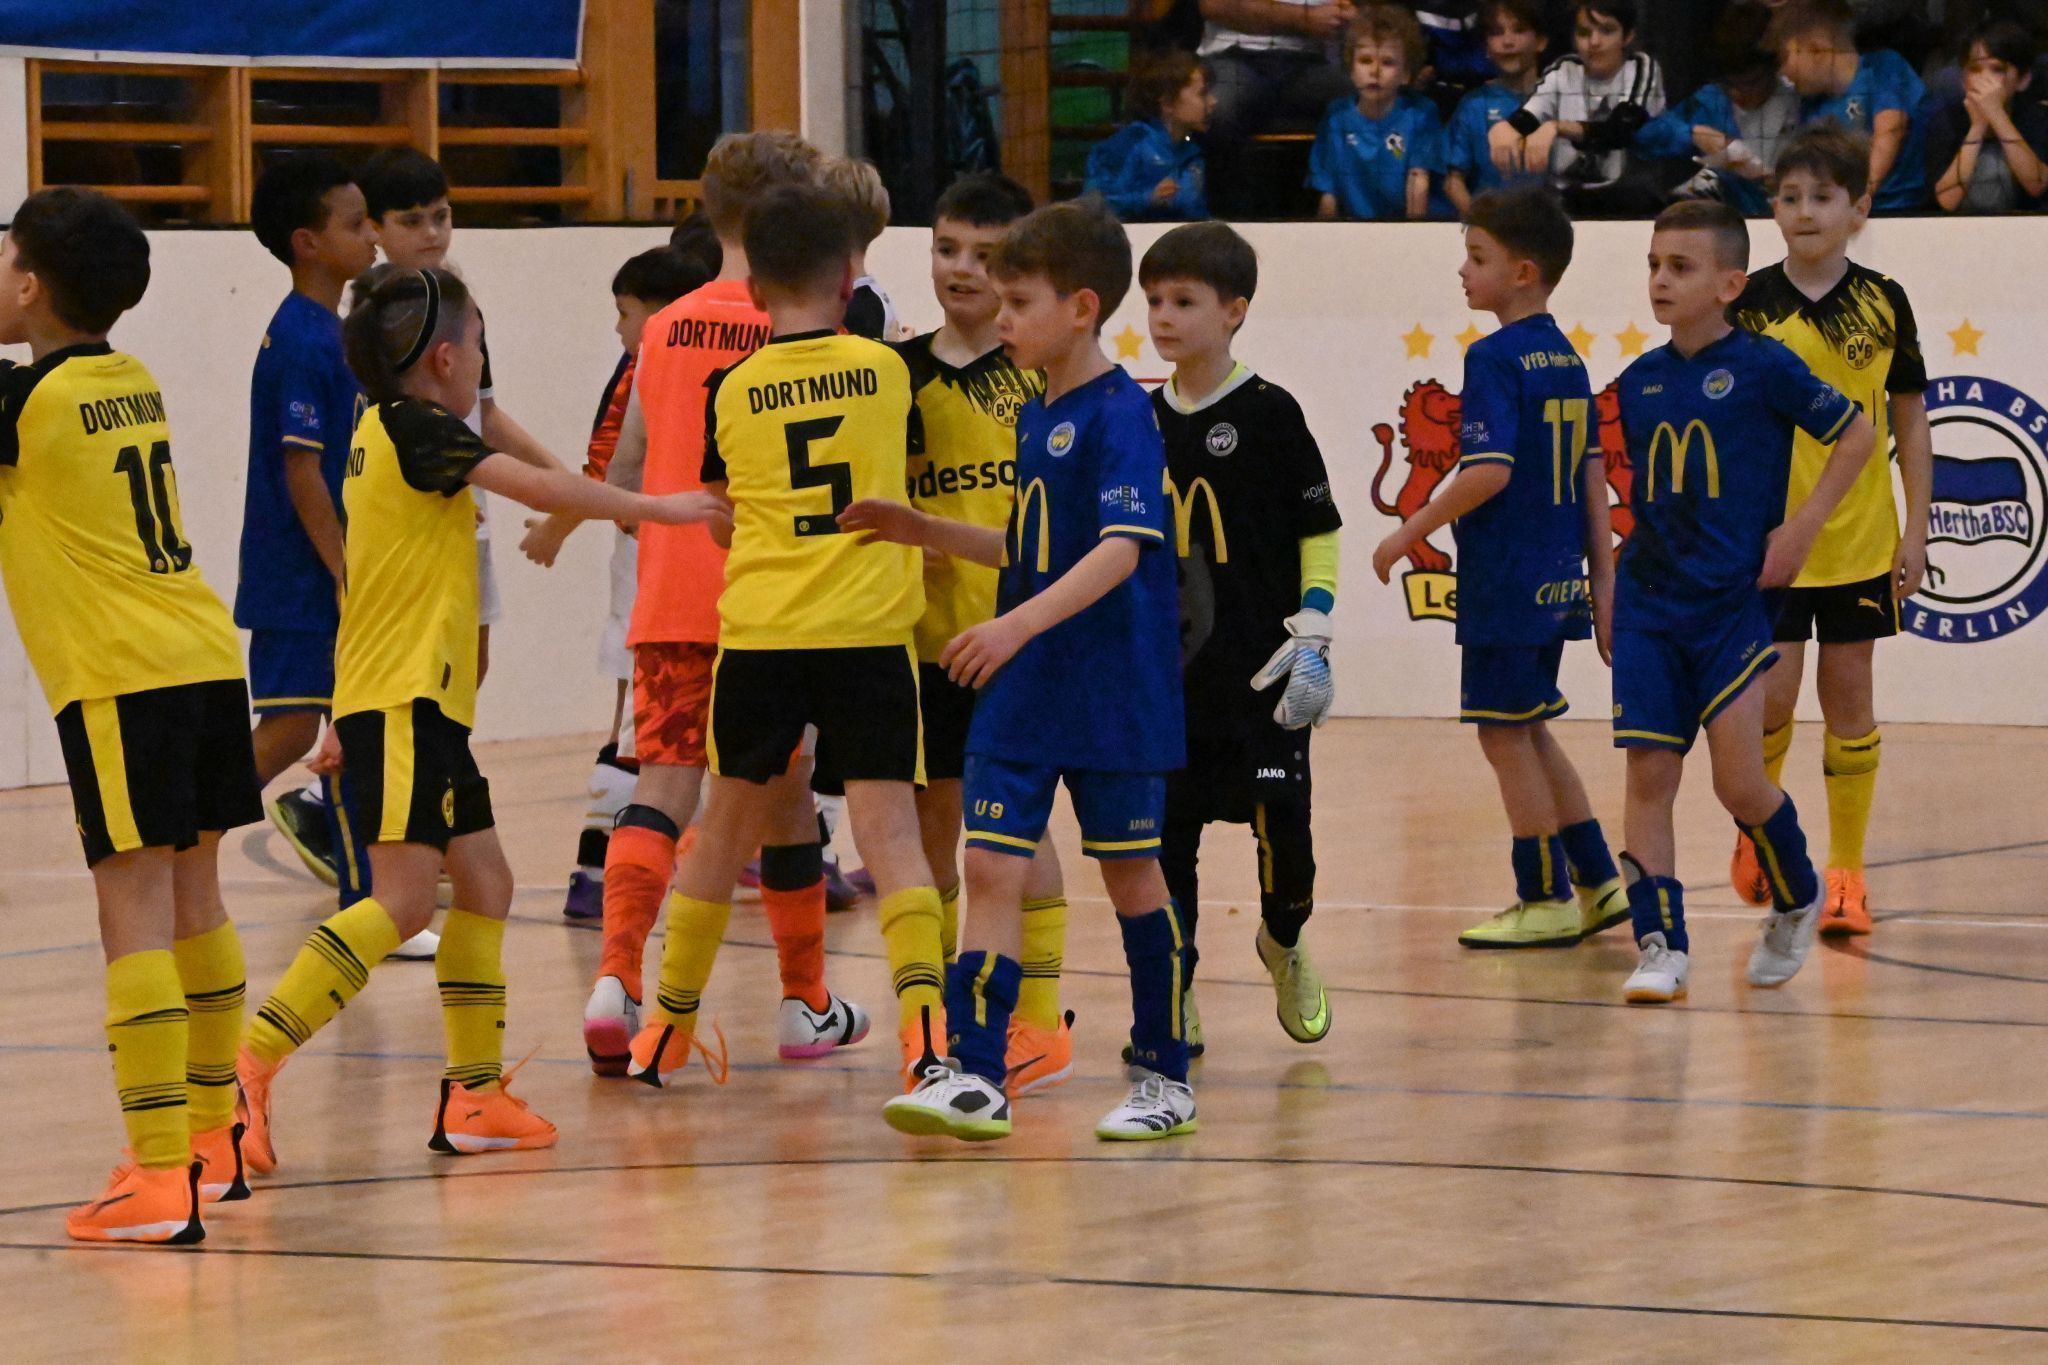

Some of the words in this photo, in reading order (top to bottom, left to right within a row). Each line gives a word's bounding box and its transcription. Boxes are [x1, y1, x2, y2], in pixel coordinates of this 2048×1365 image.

[667, 318, 772, 352] DORTMUN
[1848, 337, 1873, 361] BVB
[1519, 351, 1549, 371] VfB
[748, 368, 878, 414] DORTMUND
[996, 397, 1022, 417] BVB
[79, 391, 167, 436] DORTMUN
[2009, 396, 2048, 453] BS
[1543, 398, 1588, 505] 17
[784, 415, 853, 537] 5
[114, 440, 193, 574] 10
[1424, 580, 1458, 612] Le
[1901, 600, 2030, 638] ERLIN
[1256, 767, 1286, 779] JAKO
